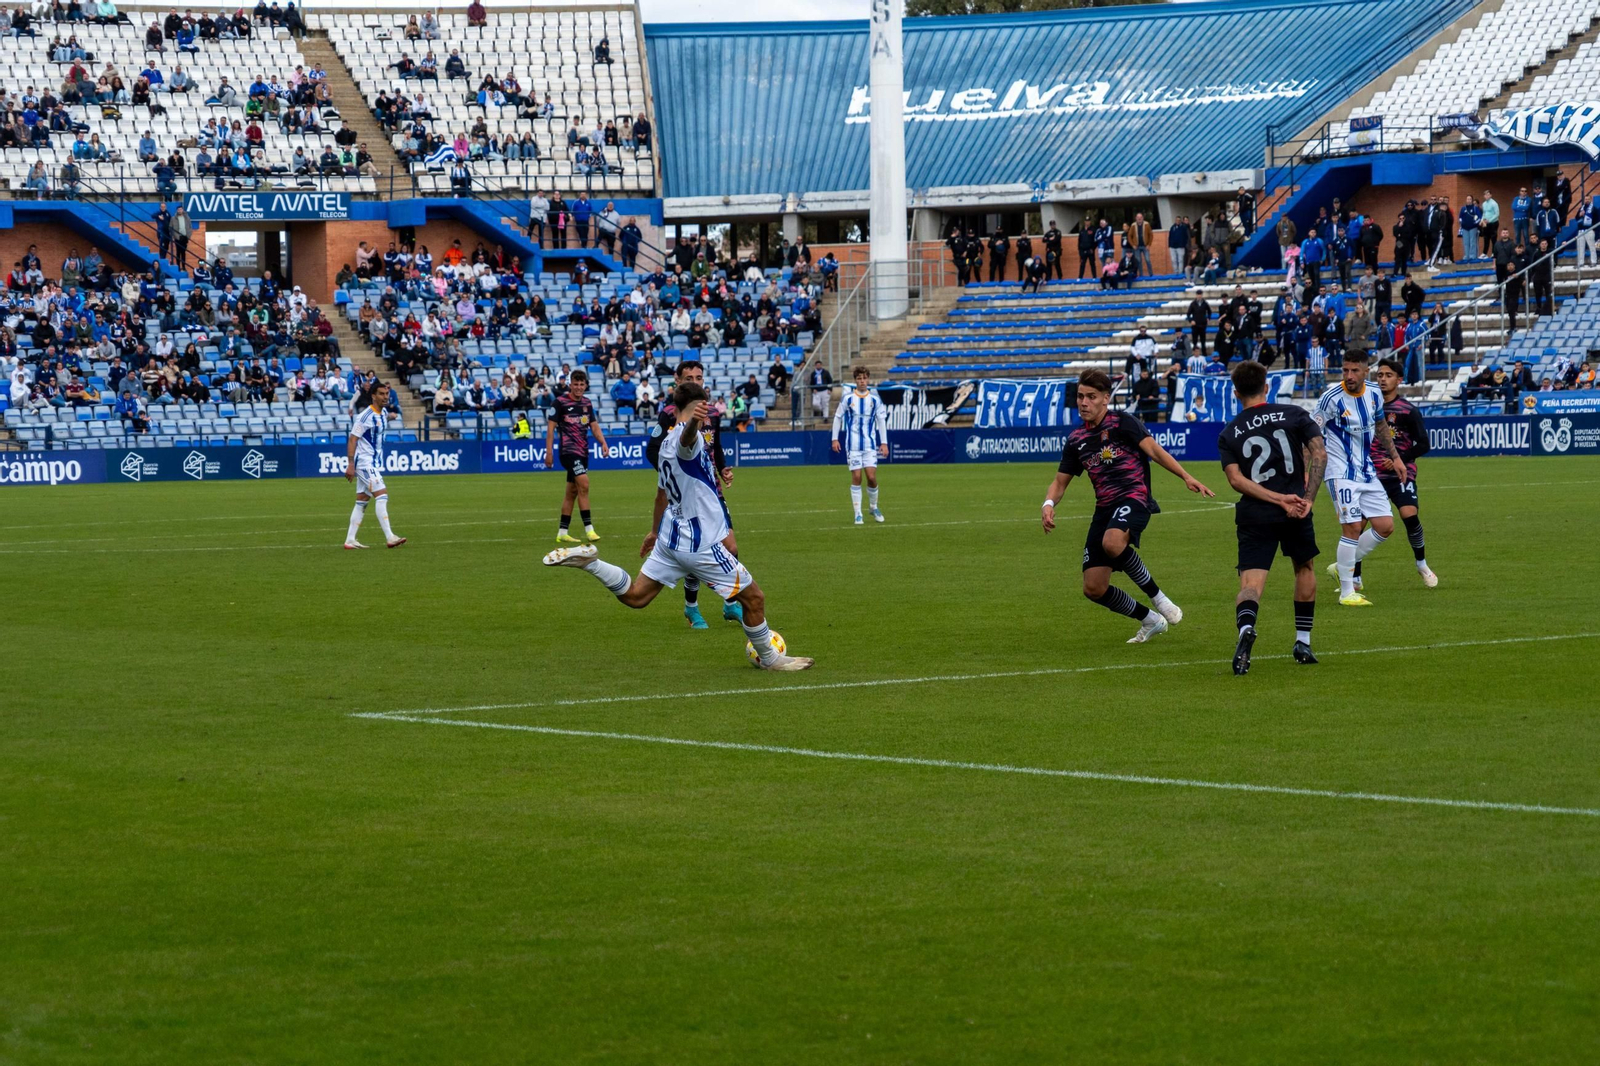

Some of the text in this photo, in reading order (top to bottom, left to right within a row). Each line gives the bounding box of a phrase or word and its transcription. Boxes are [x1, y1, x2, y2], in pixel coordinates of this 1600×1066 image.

[186, 193, 347, 212] AVATEL AVATEL
[1542, 398, 1560, 407] PEÑA
[1246, 412, 1286, 430] LÓPEZ
[1466, 422, 1530, 449] COSTALUZ
[981, 436, 1029, 454] ATRACCIONES
[1030, 437, 1039, 453] LA
[1041, 436, 1060, 453] CINTA
[386, 450, 410, 472] de
[410, 449, 459, 472] Palos
[622, 459, 643, 468] original
[1242, 428, 1294, 484] 21
[1338, 488, 1353, 505] 10
[1400, 482, 1415, 494] 14
[1112, 505, 1131, 519] 19
